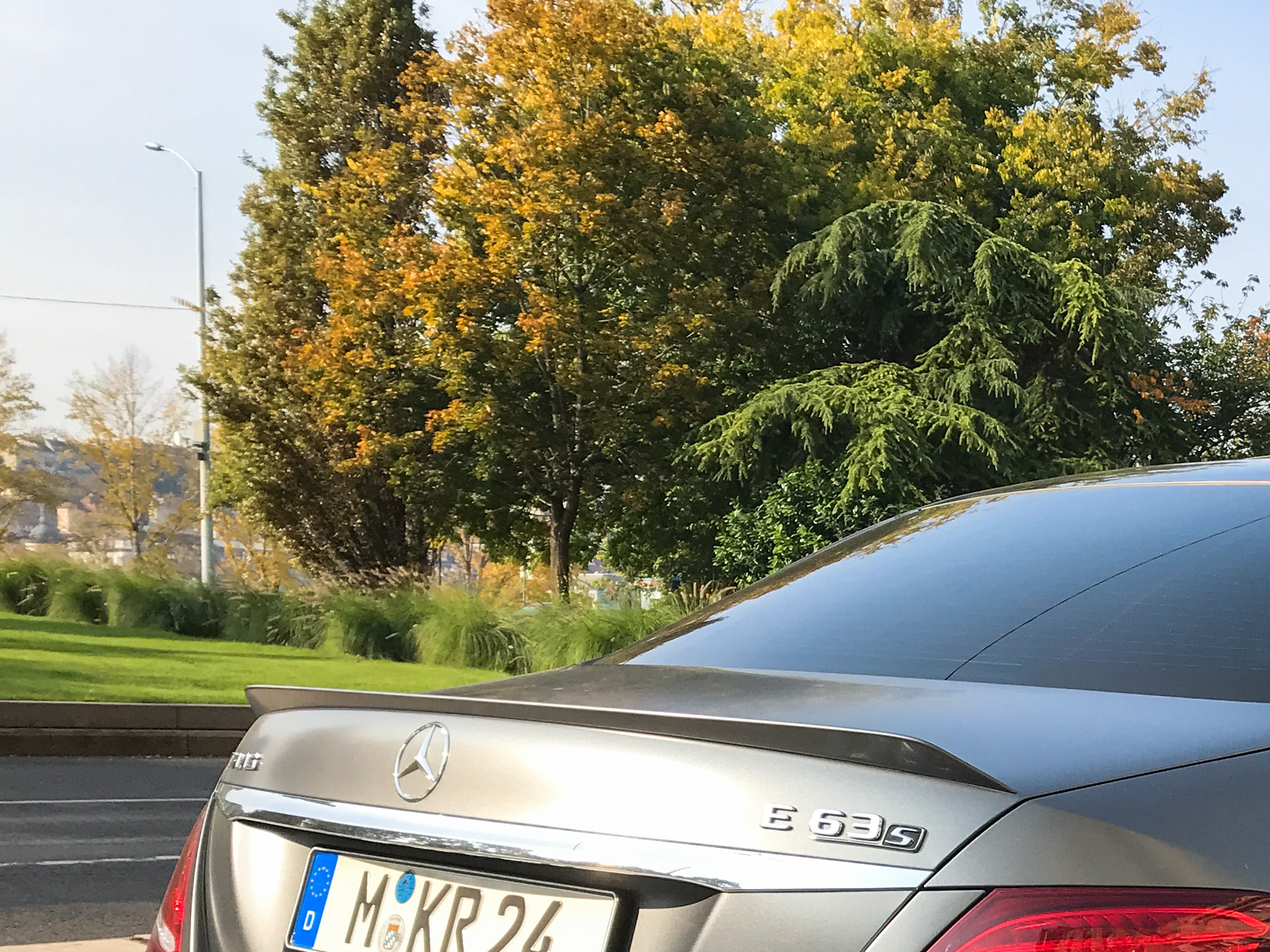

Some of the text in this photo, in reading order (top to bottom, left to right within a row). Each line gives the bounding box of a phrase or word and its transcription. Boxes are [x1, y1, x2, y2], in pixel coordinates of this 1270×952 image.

[759, 803, 798, 831] E
[302, 909, 316, 931] D
[344, 870, 390, 948] M
